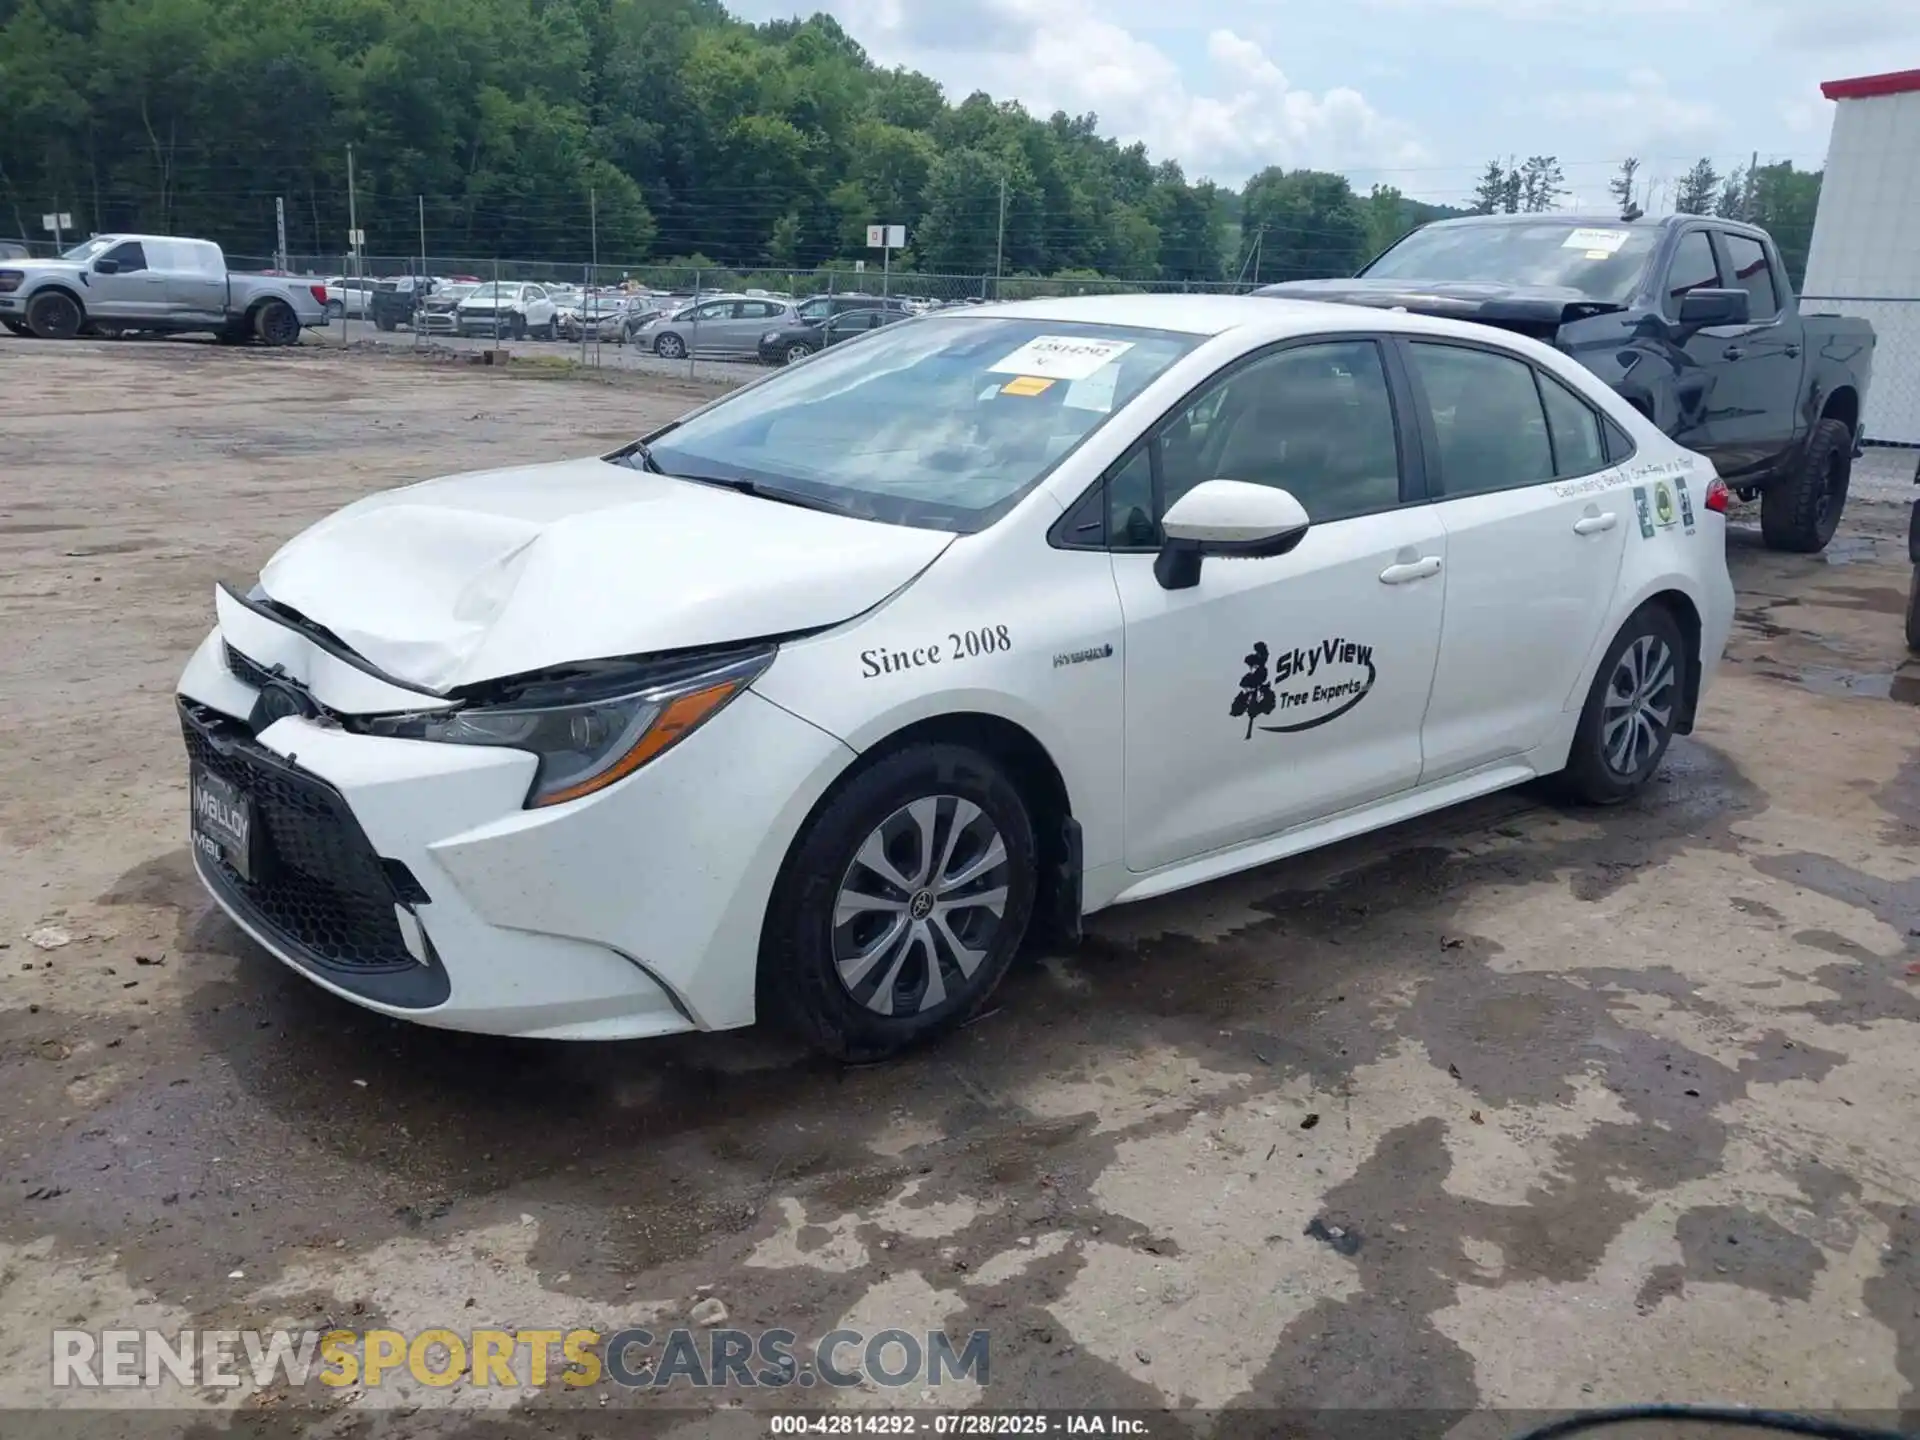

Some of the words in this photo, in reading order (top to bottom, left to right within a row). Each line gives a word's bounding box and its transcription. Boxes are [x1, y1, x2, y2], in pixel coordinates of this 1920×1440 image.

[861, 645, 942, 678] Since
[948, 624, 1012, 660] 2008
[1274, 638, 1373, 685] SkyView
[1280, 691, 1309, 709] Tree
[1312, 680, 1361, 703] Experts
